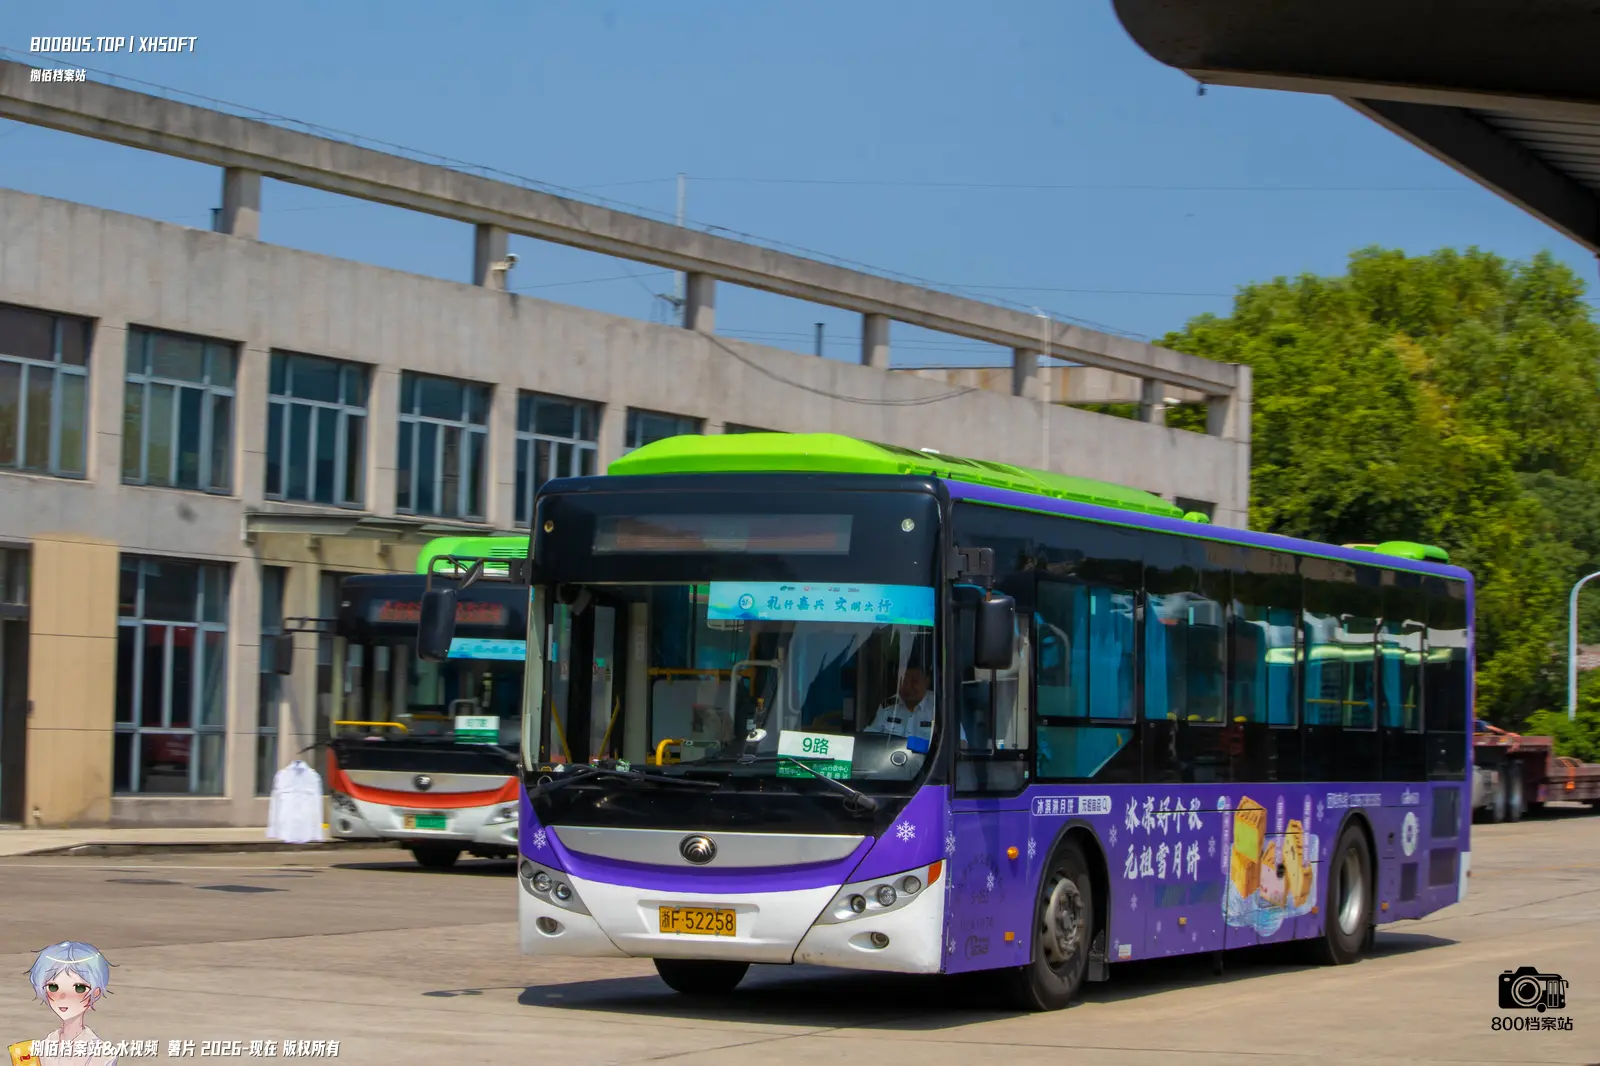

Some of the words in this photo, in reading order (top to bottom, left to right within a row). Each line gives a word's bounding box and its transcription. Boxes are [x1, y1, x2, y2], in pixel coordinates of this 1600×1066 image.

[802, 737, 829, 755] 9路
[1124, 840, 1200, 881] 元祖雪月饼
